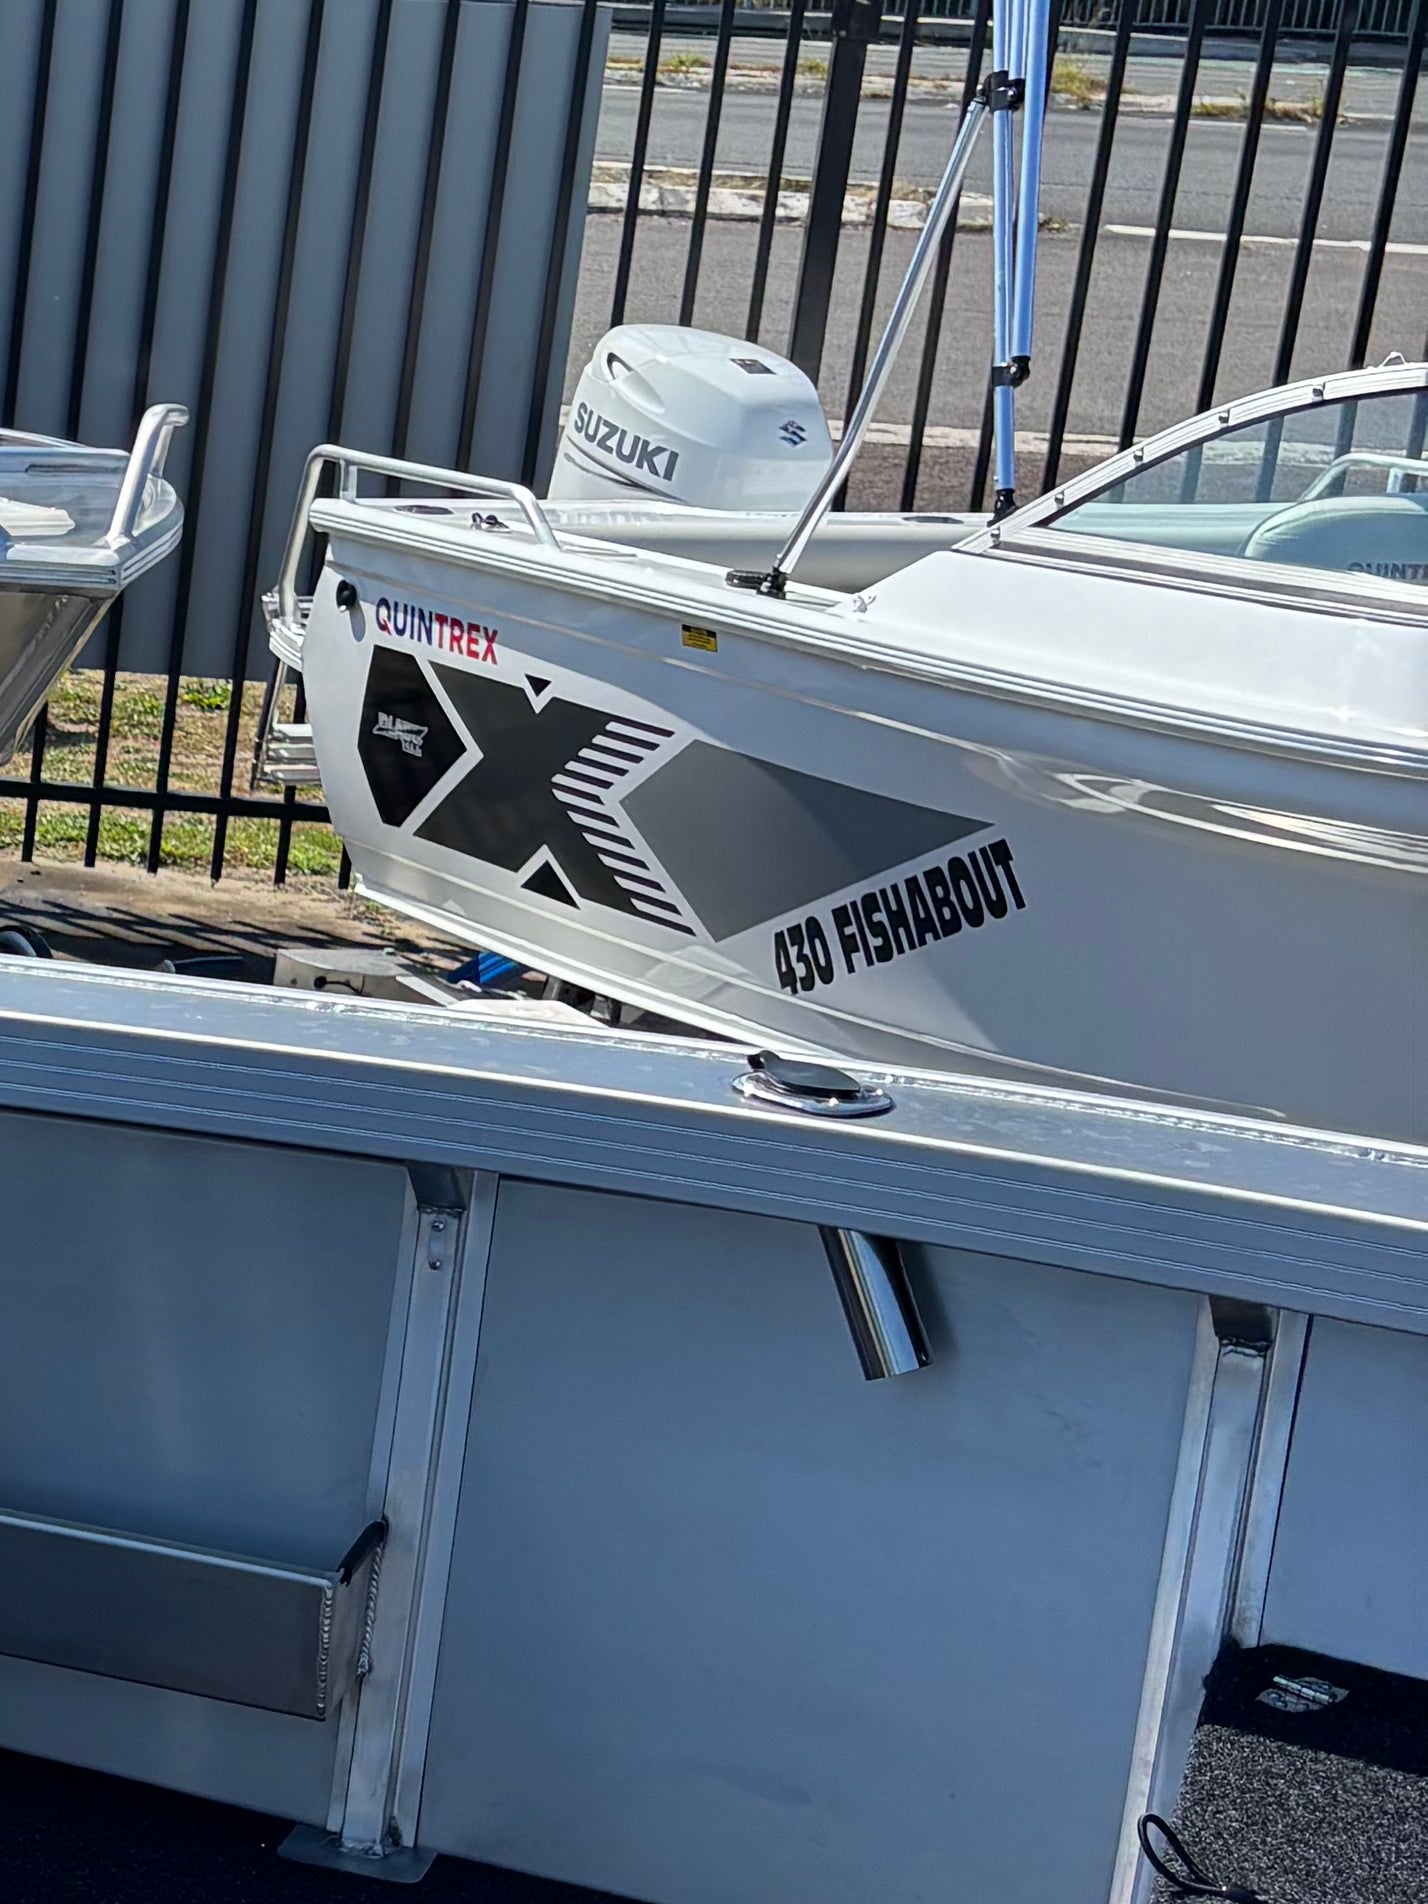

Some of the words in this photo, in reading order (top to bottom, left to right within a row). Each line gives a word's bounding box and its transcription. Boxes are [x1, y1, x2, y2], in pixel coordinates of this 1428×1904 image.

[574, 402, 680, 482] SUZUKI
[375, 597, 499, 665] QUINTREX
[774, 916, 835, 995] 430
[831, 838, 1026, 974] FISHABOUT
